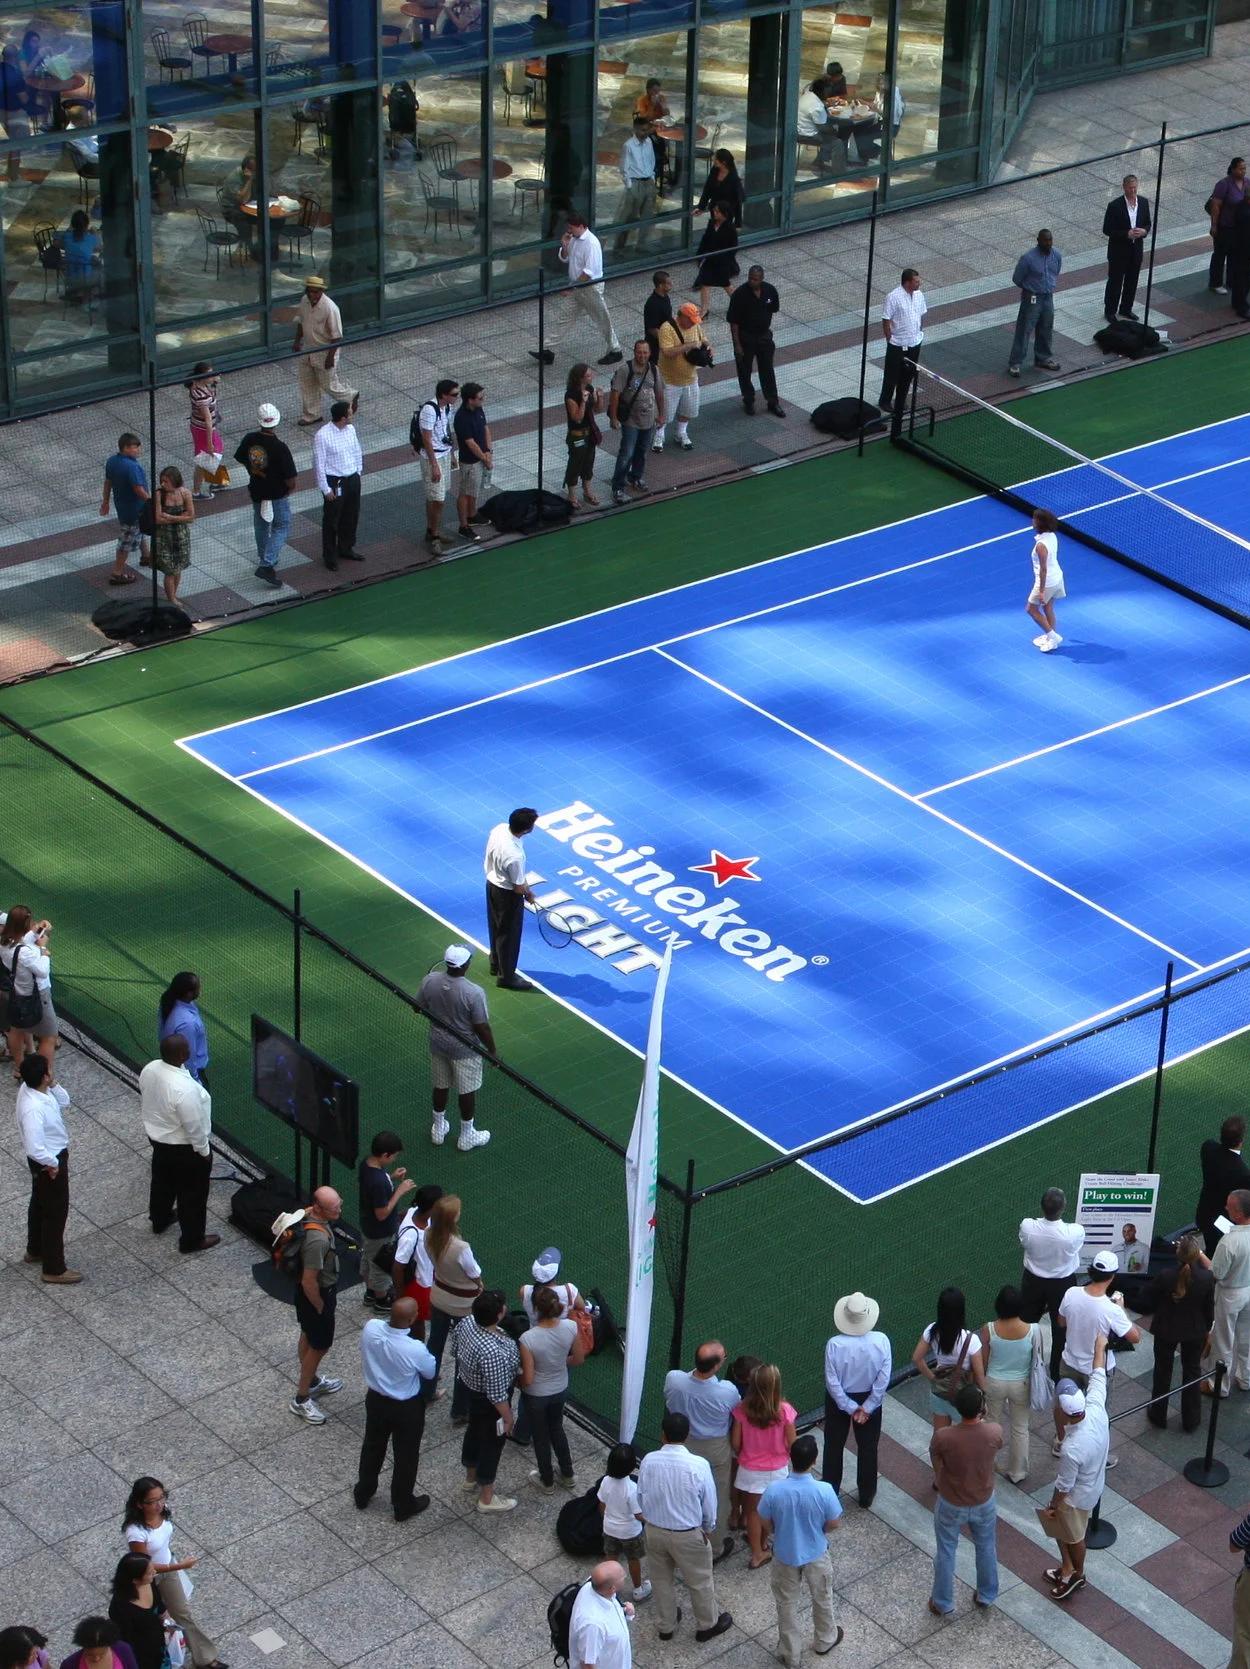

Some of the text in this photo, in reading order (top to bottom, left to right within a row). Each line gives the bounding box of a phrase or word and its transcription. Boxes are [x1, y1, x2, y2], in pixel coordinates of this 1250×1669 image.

[557, 865, 693, 950] PREMIUM
[1084, 1190, 1148, 1202] Play to win!
